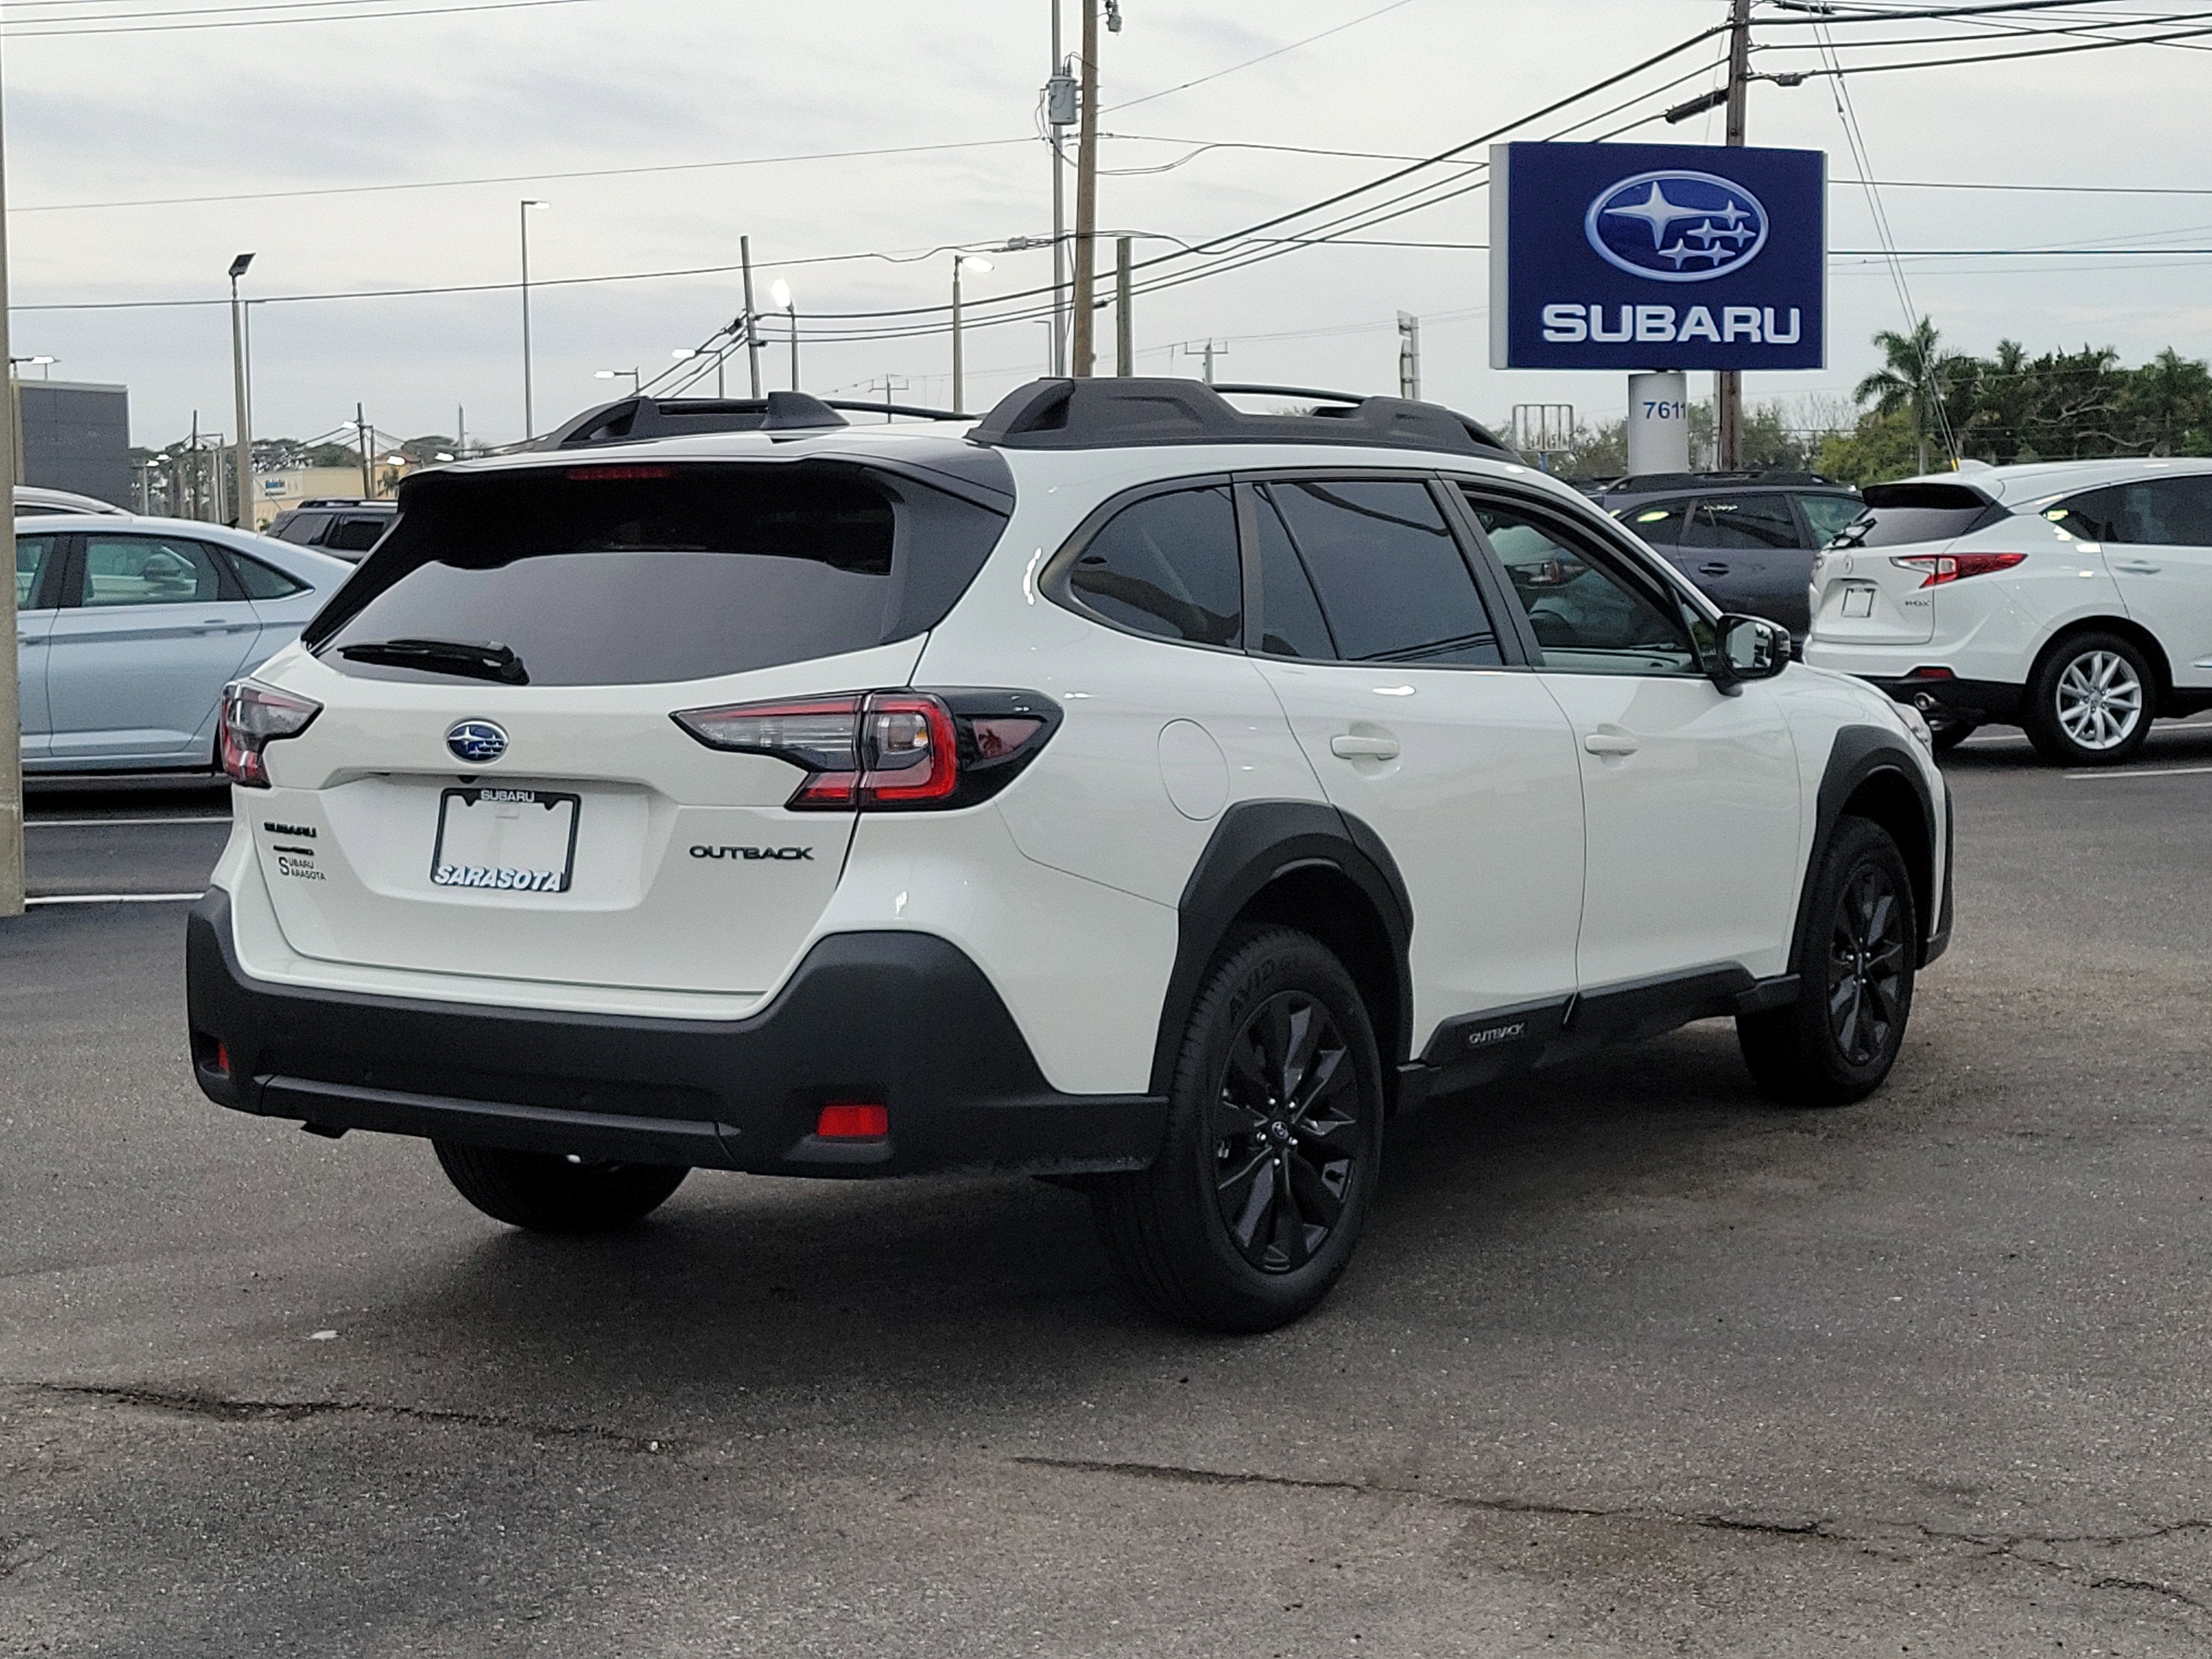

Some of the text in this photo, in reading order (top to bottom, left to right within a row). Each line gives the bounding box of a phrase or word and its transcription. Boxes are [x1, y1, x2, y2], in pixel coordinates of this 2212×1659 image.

[1543, 304, 1800, 343] SUBARU
[1643, 401, 1686, 419] 7611
[481, 789, 535, 802] SUBARU
[689, 845, 814, 860] OUTBACK
[435, 864, 564, 891] SARASOTA
[1469, 1022, 1525, 1044] OUTBACK
